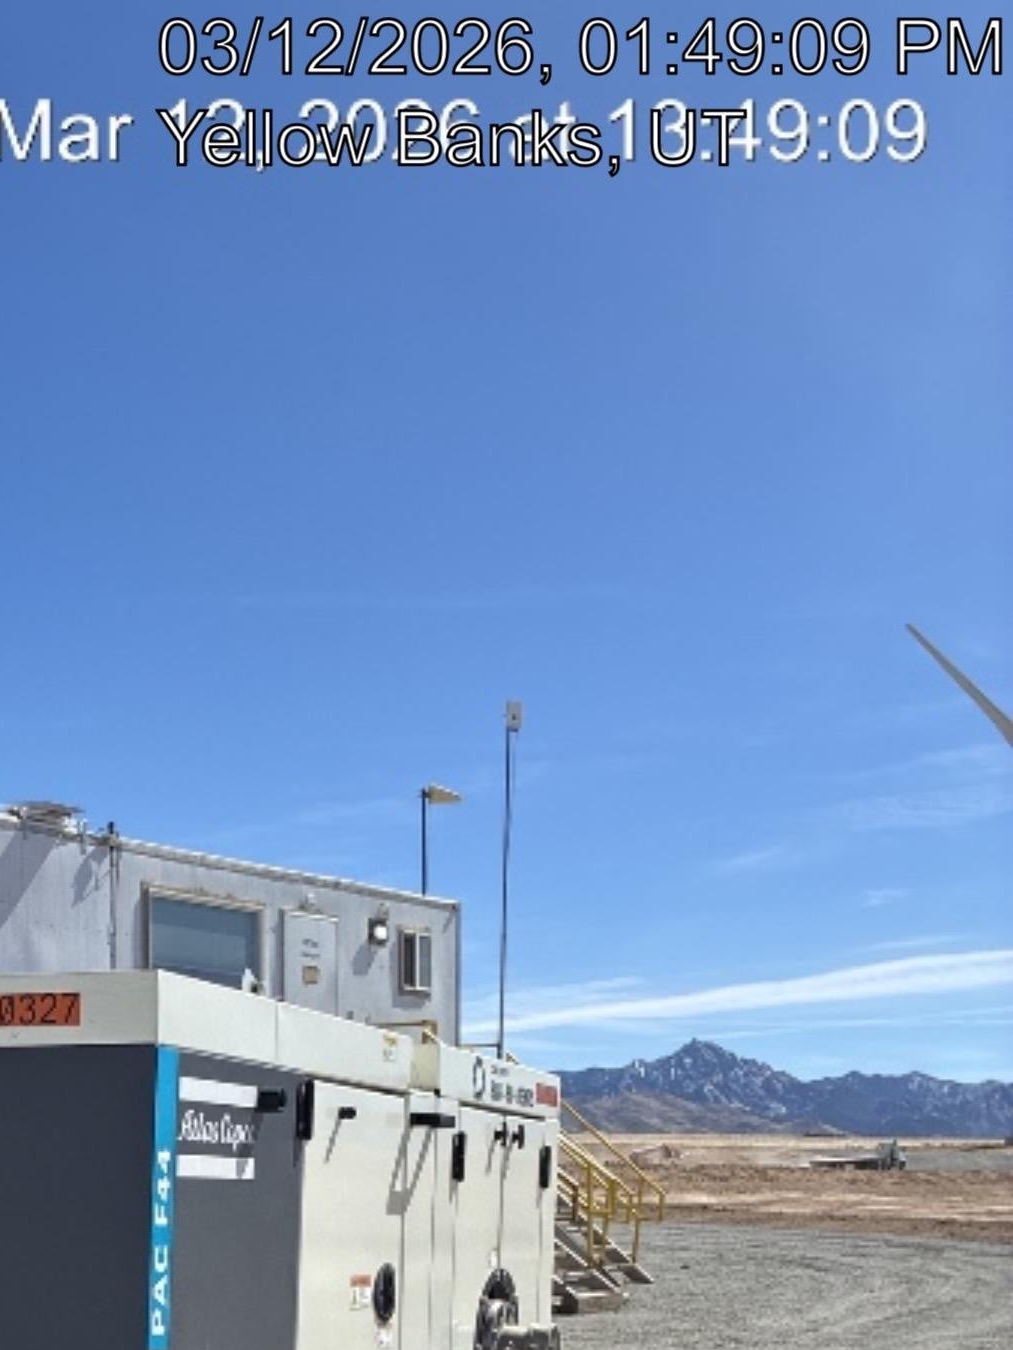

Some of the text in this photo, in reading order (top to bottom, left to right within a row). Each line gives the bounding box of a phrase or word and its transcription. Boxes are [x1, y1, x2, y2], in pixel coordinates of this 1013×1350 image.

[177, 1109, 219, 1144] Atlas
[151, 1150, 172, 1337] PAC F44
